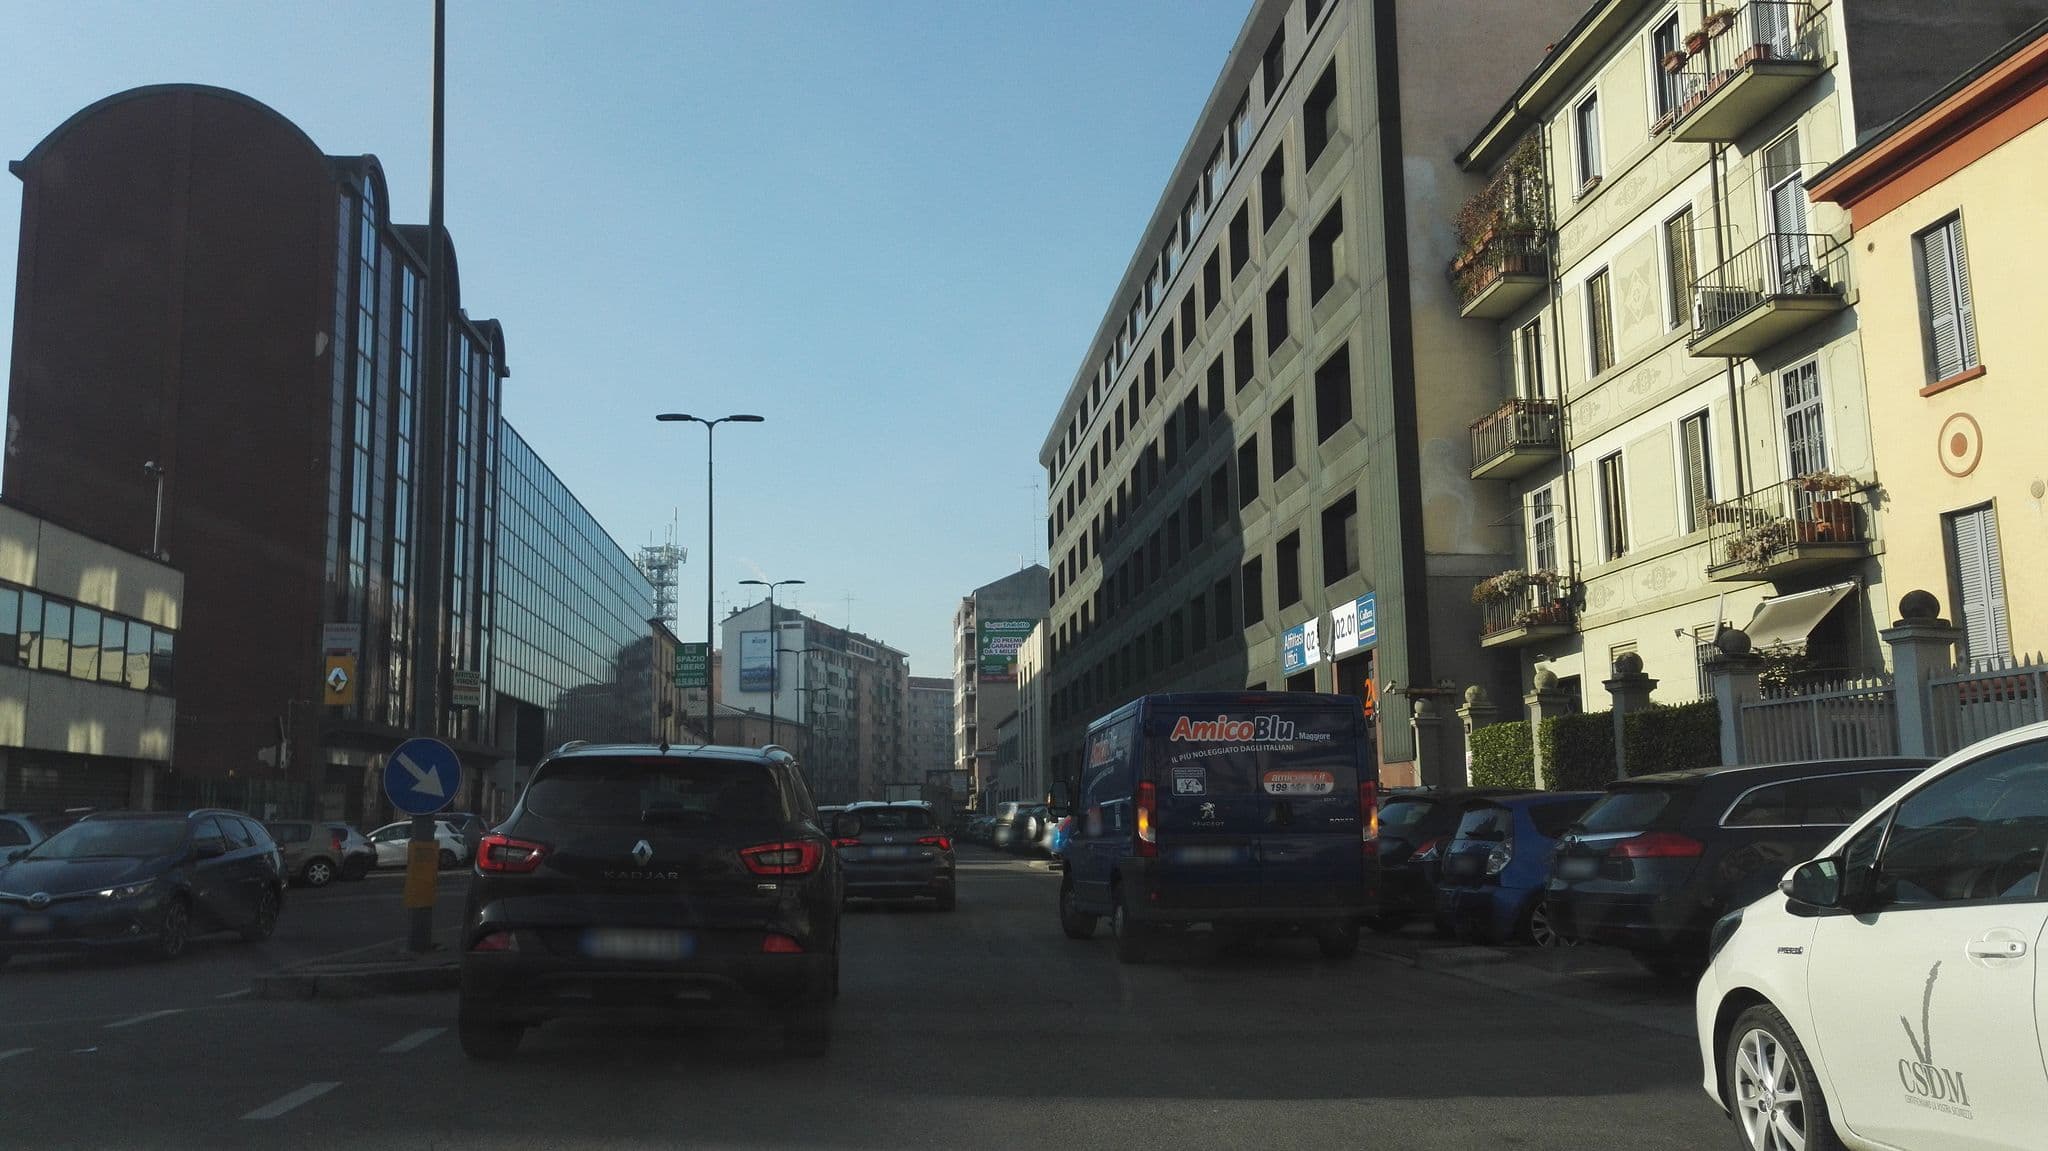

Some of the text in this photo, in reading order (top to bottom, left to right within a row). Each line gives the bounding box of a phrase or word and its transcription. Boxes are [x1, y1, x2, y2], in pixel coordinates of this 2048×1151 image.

[1335, 613, 1356, 640] 02.01
[1170, 714, 1295, 742] AmicoBlu
[1299, 732, 1331, 742] Maggiore
[1192, 745, 1239, 758] NOLEGGIATO
[1240, 744, 1261, 752] DAGLI
[1262, 744, 1294, 752] ITALIANI
[604, 871, 680, 880] KADJAR
[1899, 1058, 1970, 1107] CSDM
